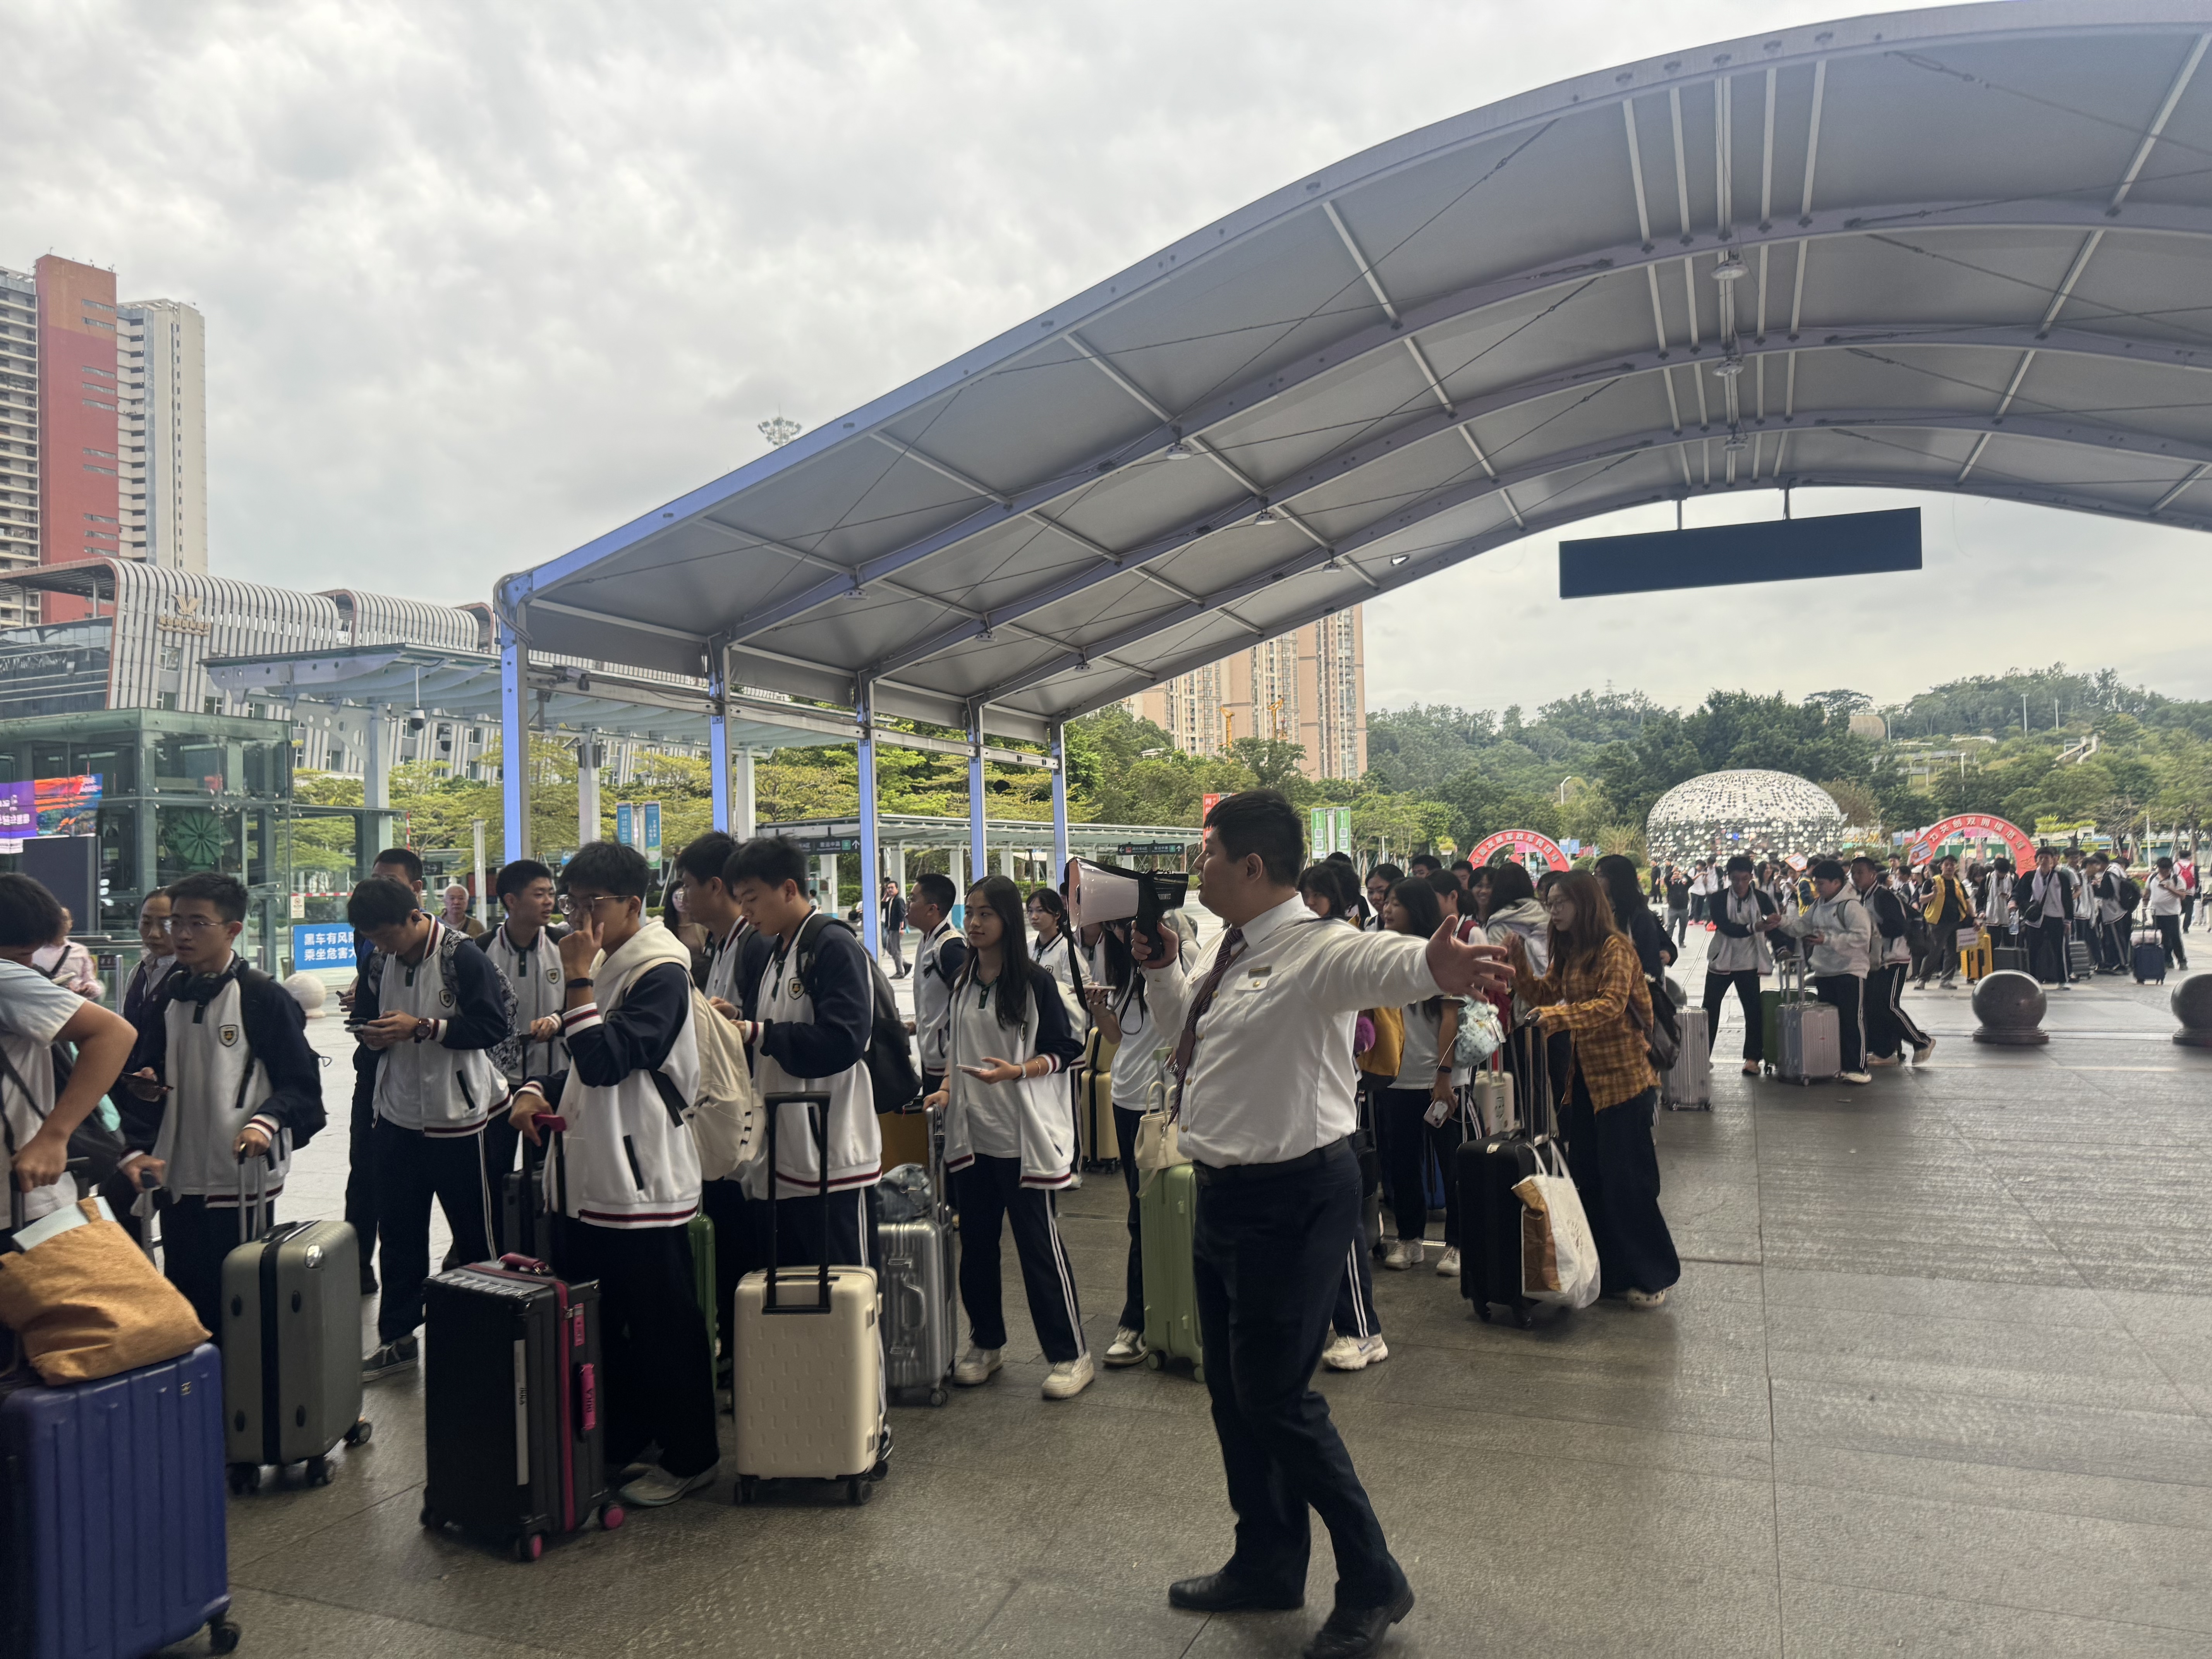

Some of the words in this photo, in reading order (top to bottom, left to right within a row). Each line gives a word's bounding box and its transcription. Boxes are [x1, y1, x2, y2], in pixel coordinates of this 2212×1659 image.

[304, 947, 356, 961] 乘坐危害大
